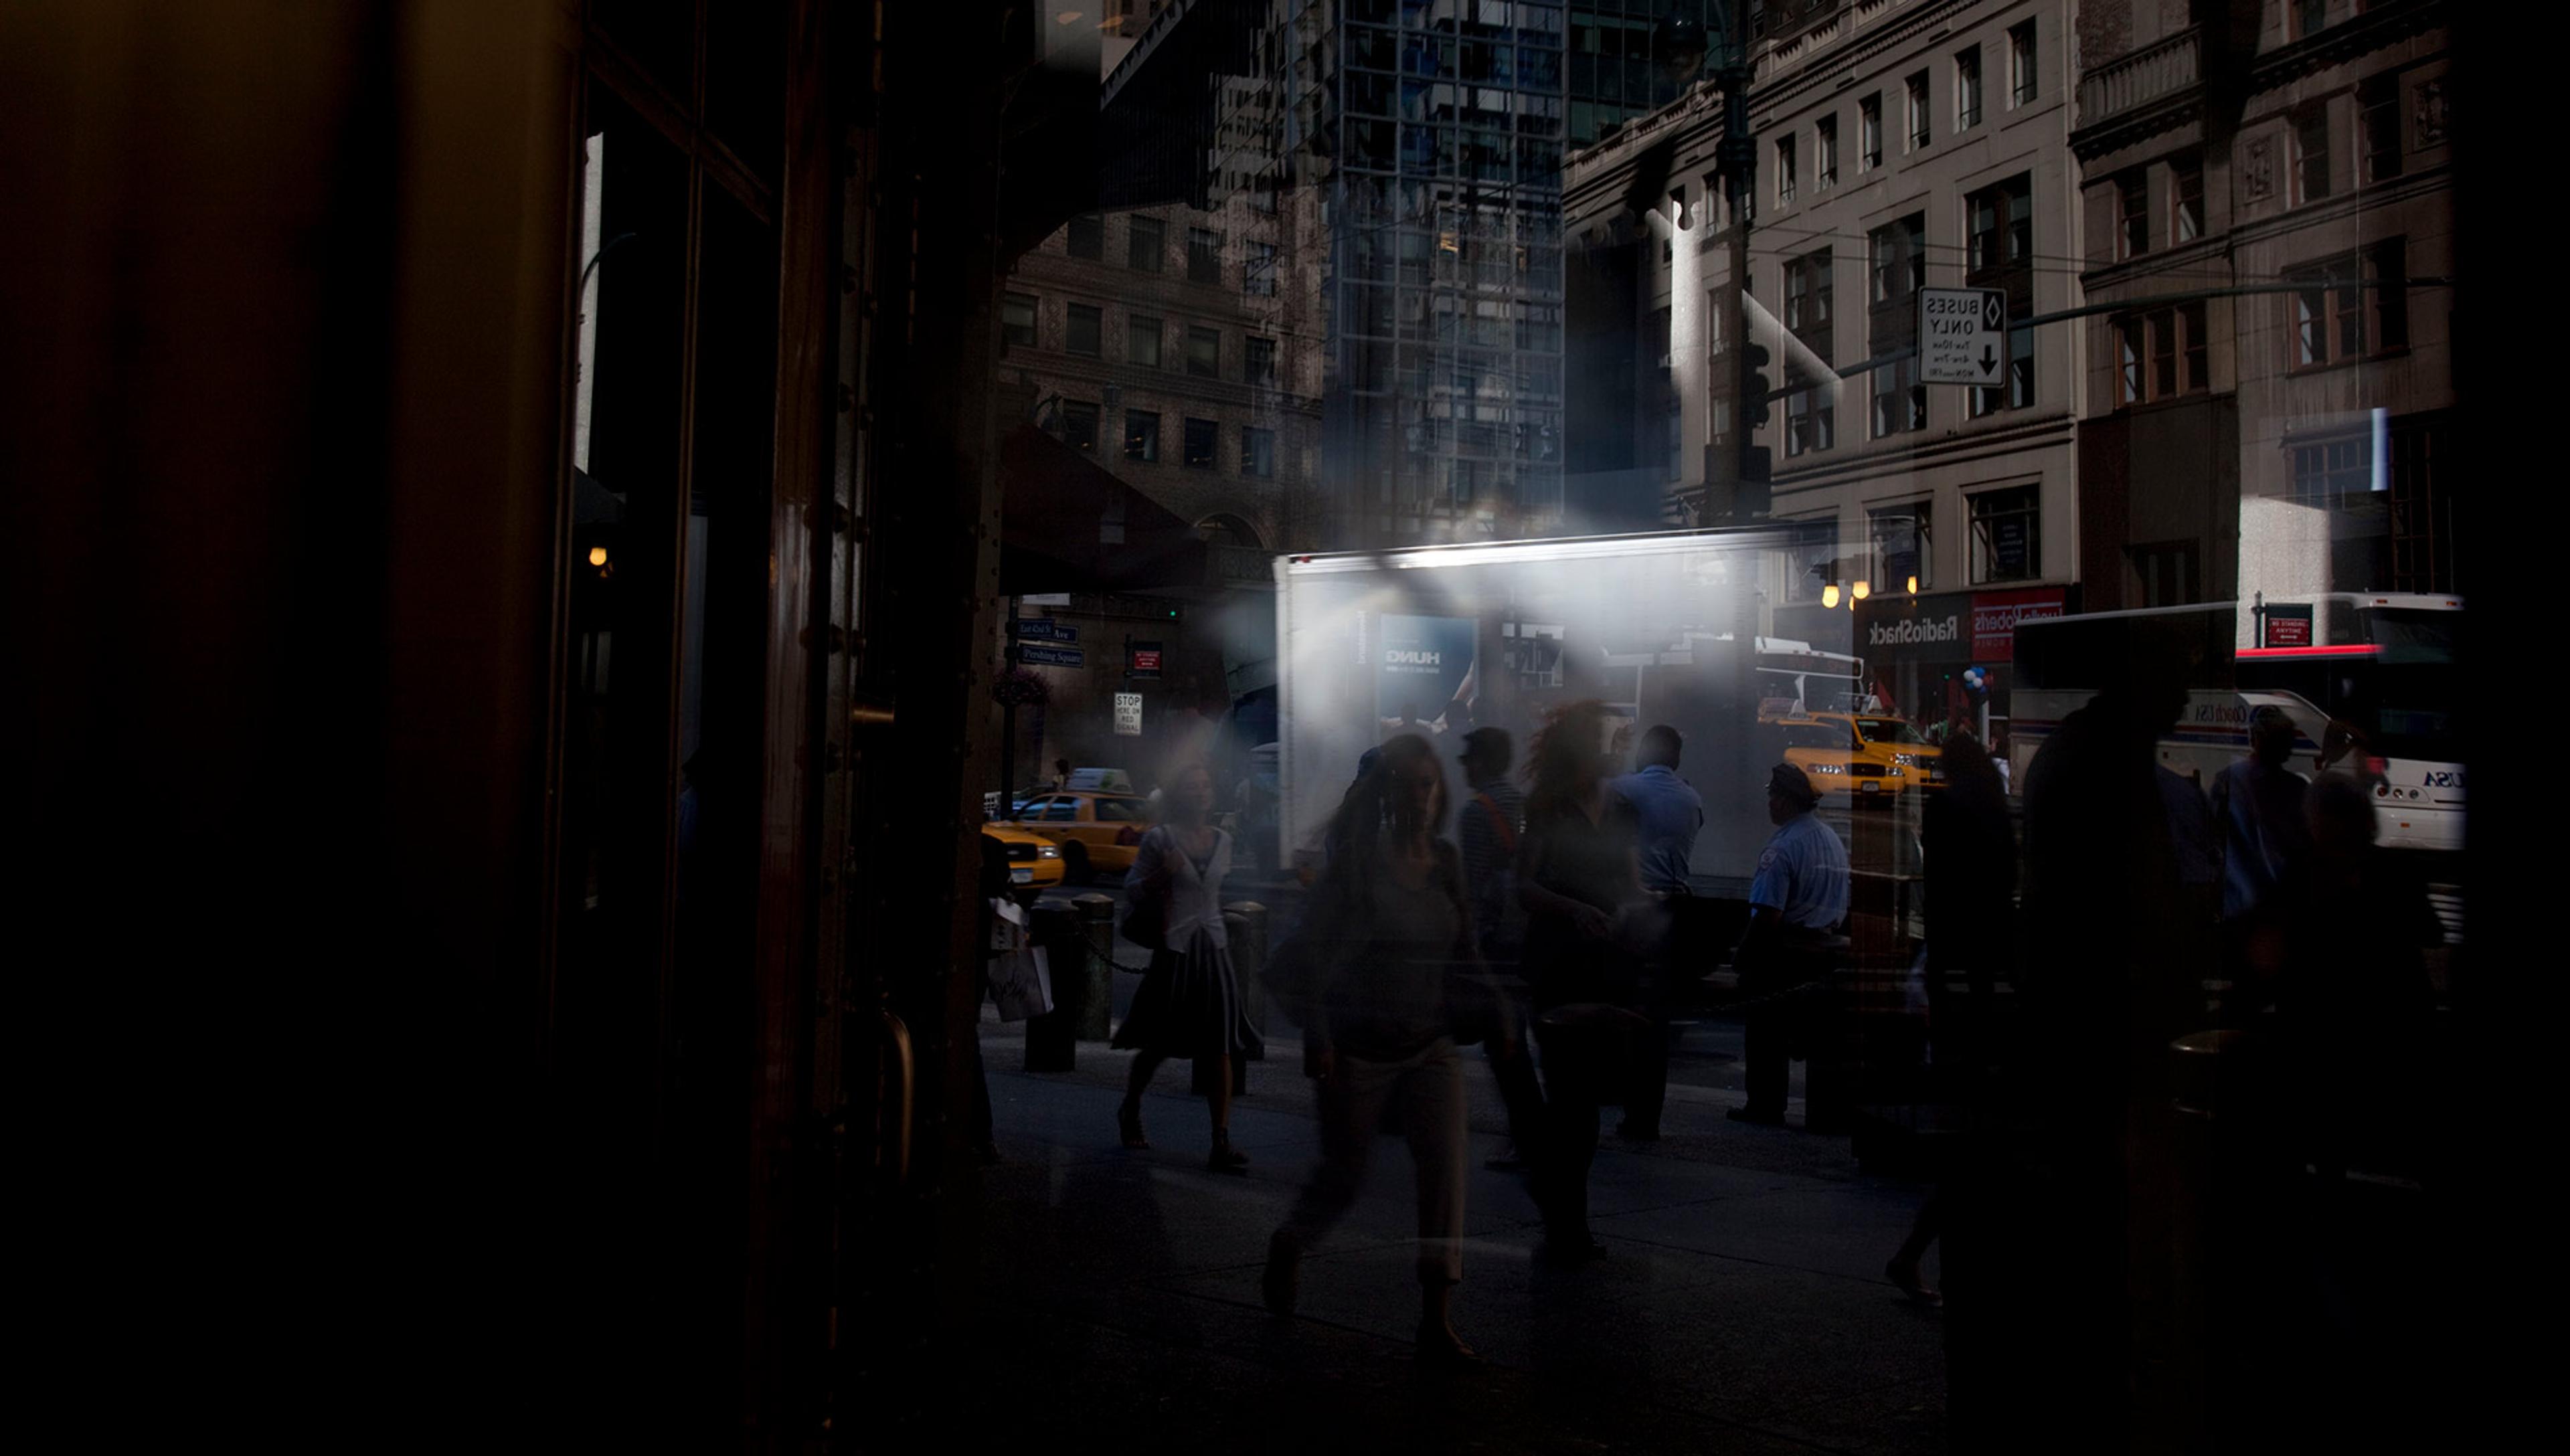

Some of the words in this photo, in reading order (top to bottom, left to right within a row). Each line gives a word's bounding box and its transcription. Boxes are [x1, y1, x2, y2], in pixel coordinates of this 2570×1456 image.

[1054, 630, 1069, 640] Ave
[1023, 648, 1056, 662] Pershing
[1057, 652, 1082, 664] Square
[1117, 696, 1141, 706] STOP
